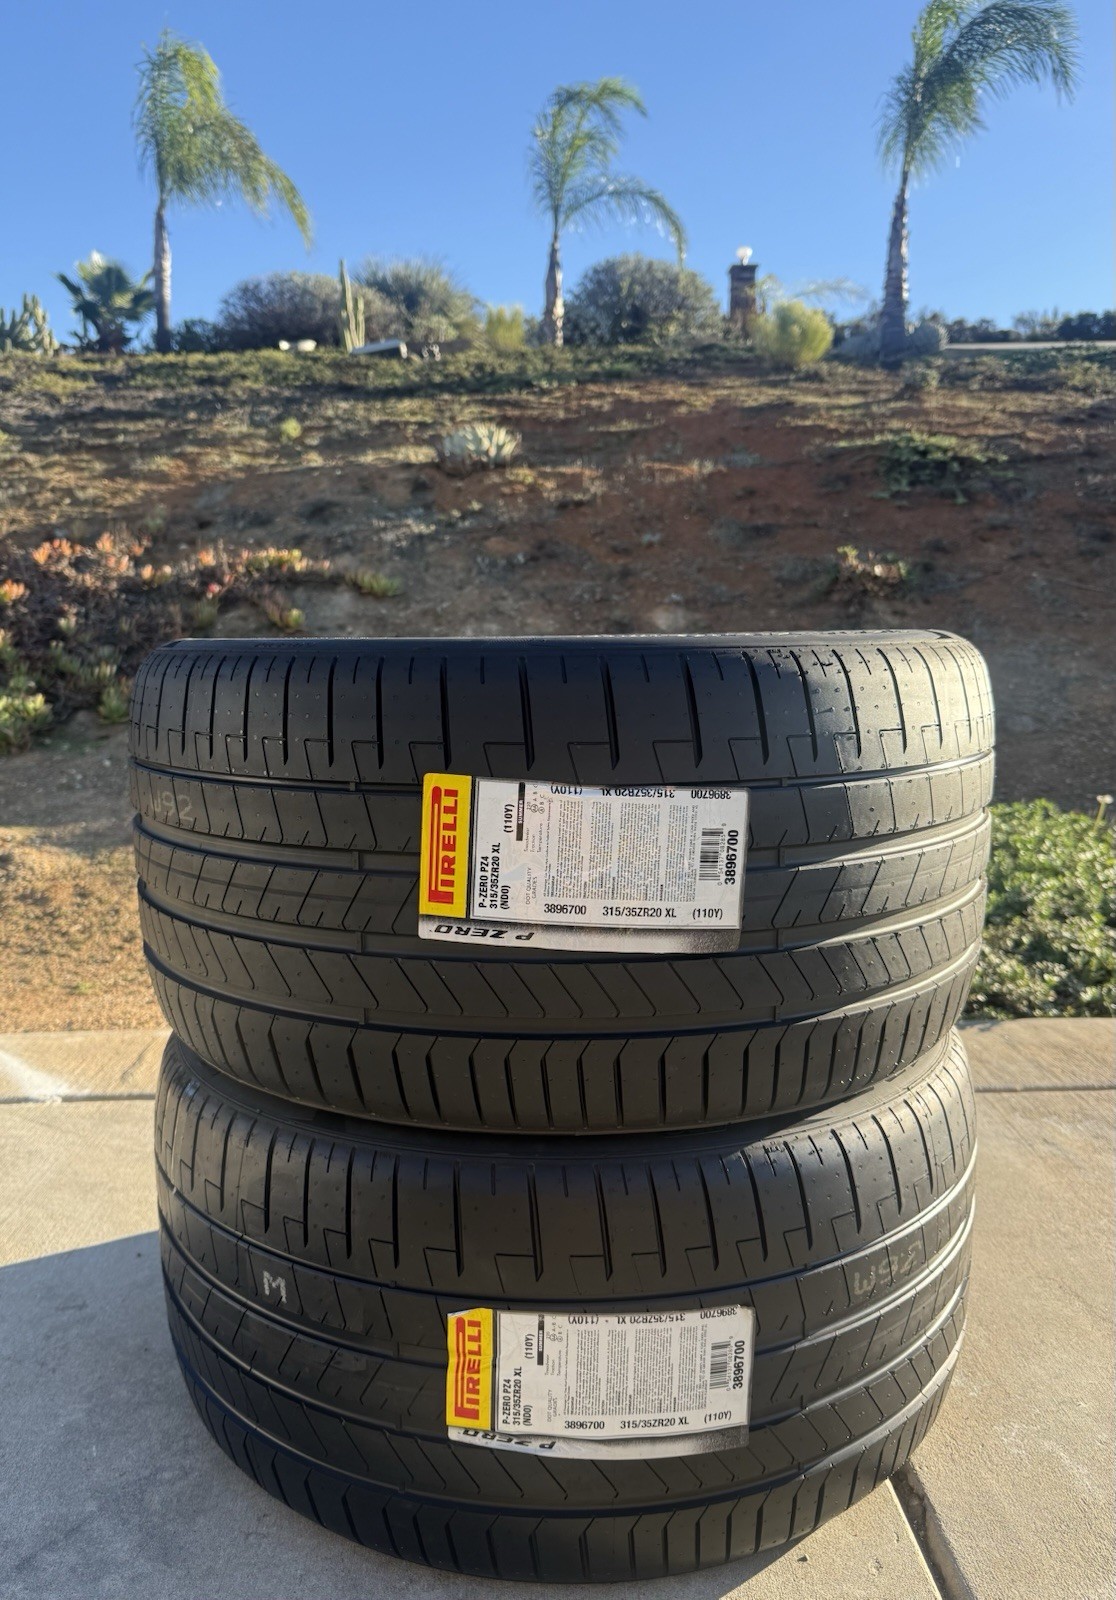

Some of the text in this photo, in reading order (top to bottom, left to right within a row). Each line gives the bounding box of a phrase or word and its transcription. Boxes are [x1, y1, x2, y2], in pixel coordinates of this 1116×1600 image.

[503, 803, 515, 833] (110Y)
[428, 785, 459, 904] PIRELLI
[724, 829, 739, 885] 3896700
[480, 856, 489, 873] PZ4
[489, 842, 501, 909] 315/35ZR20 XL
[544, 904, 723, 920] 3896700 315/35ZR20 XL (110Y)
[434, 924, 535, 941] P ZERO
[262, 1270, 288, 1304] M
[568, 1314, 599, 1325] (110Y)
[615, 1316, 627, 1324] XL
[524, 1333, 535, 1359] (110Y)
[454, 1316, 481, 1421] PIRELLI
[732, 1340, 746, 1390] 3896700
[503, 1378, 512, 1394] PZ4
[513, 1366, 522, 1426] 315/35ZR20 XL
[564, 1410, 732, 1430] 3896700 315/35ZR20 XL (110Y)
